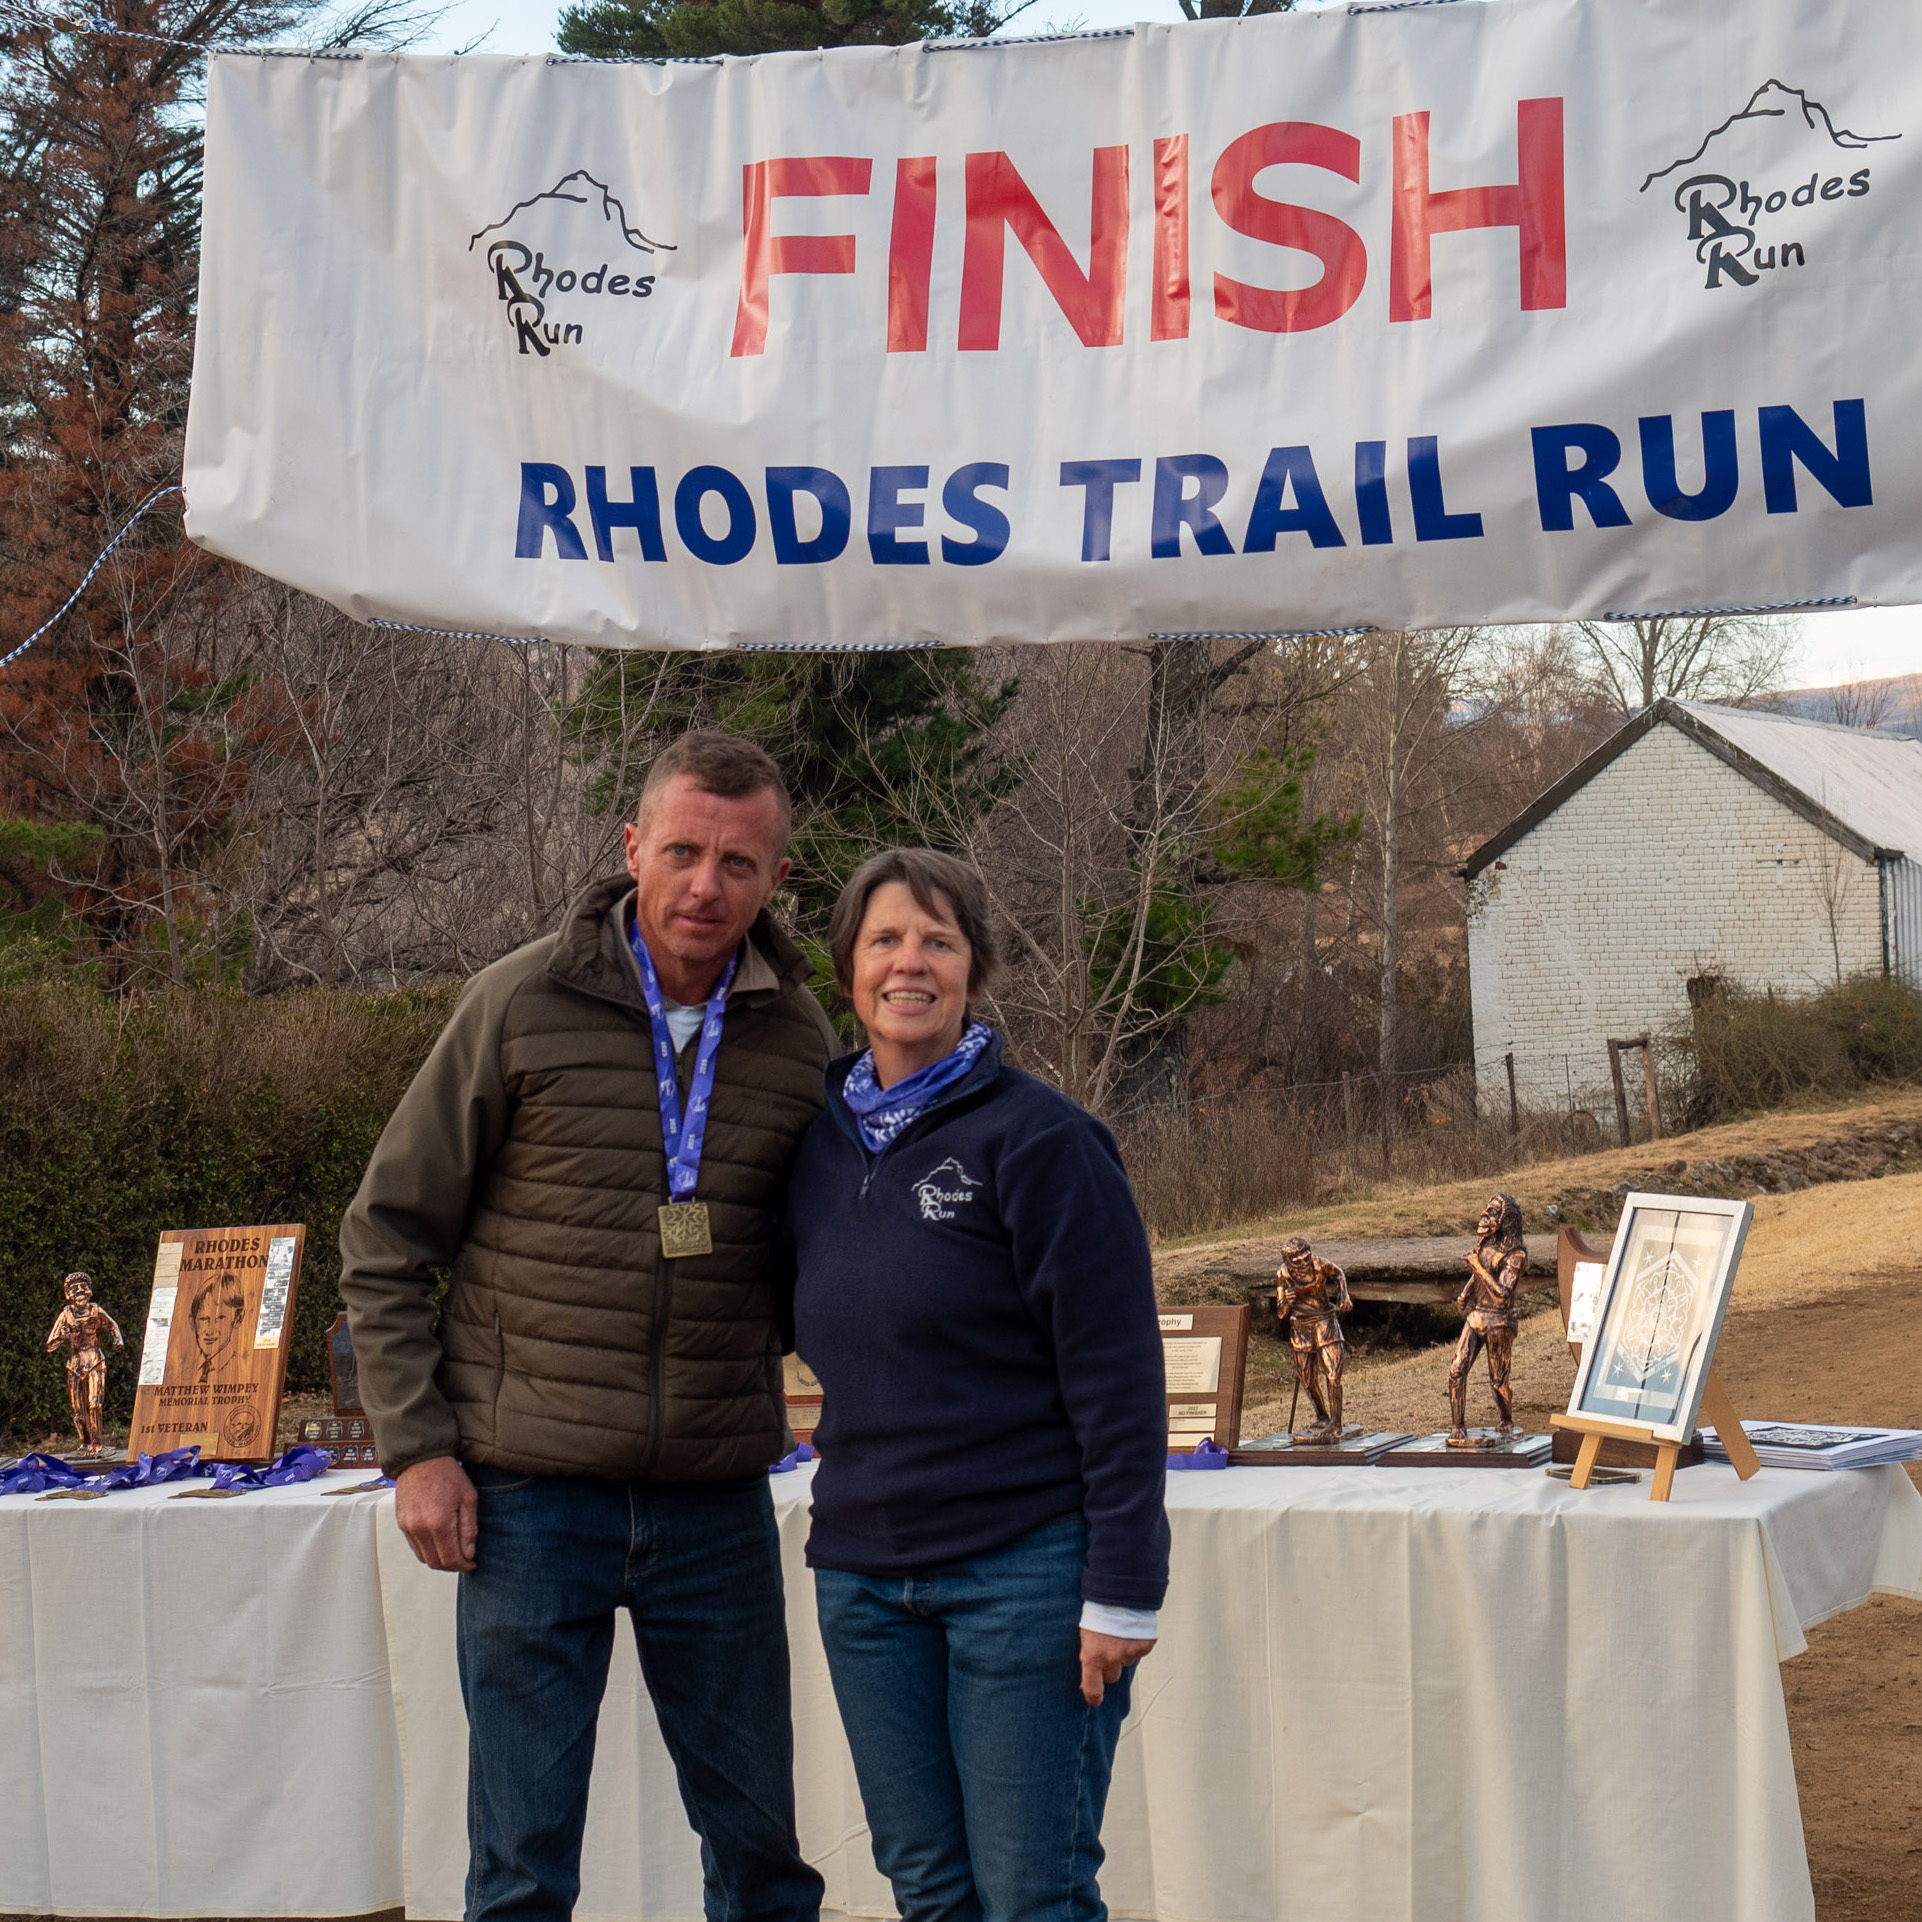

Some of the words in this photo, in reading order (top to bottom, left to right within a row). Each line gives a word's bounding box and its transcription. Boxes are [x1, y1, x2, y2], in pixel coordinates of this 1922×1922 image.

[1675, 168, 1870, 241] Rhodes
[730, 97, 1567, 357] FINISH
[487, 240, 655, 301] Rhodes
[1696, 233, 1805, 289] Run
[507, 299, 583, 357] Run
[515, 461, 1011, 567] RHODES
[1060, 436, 1483, 563] TRAIL
[1530, 398, 1873, 532] RUN
[918, 1184, 973, 1206] Rhodes
[921, 1201, 955, 1221] Run
[194, 1238, 261, 1254] RHODES
[179, 1254, 269, 1272] MARATHON
[154, 1384, 209, 1396] MATTHEW
[213, 1383, 259, 1393] WIMPEY
[158, 1397, 209, 1407] MEMORIAL
[212, 1395, 252, 1405] TROPHY
[141, 1424, 155, 1434] 1st
[158, 1422, 208, 1433] VETERAN
